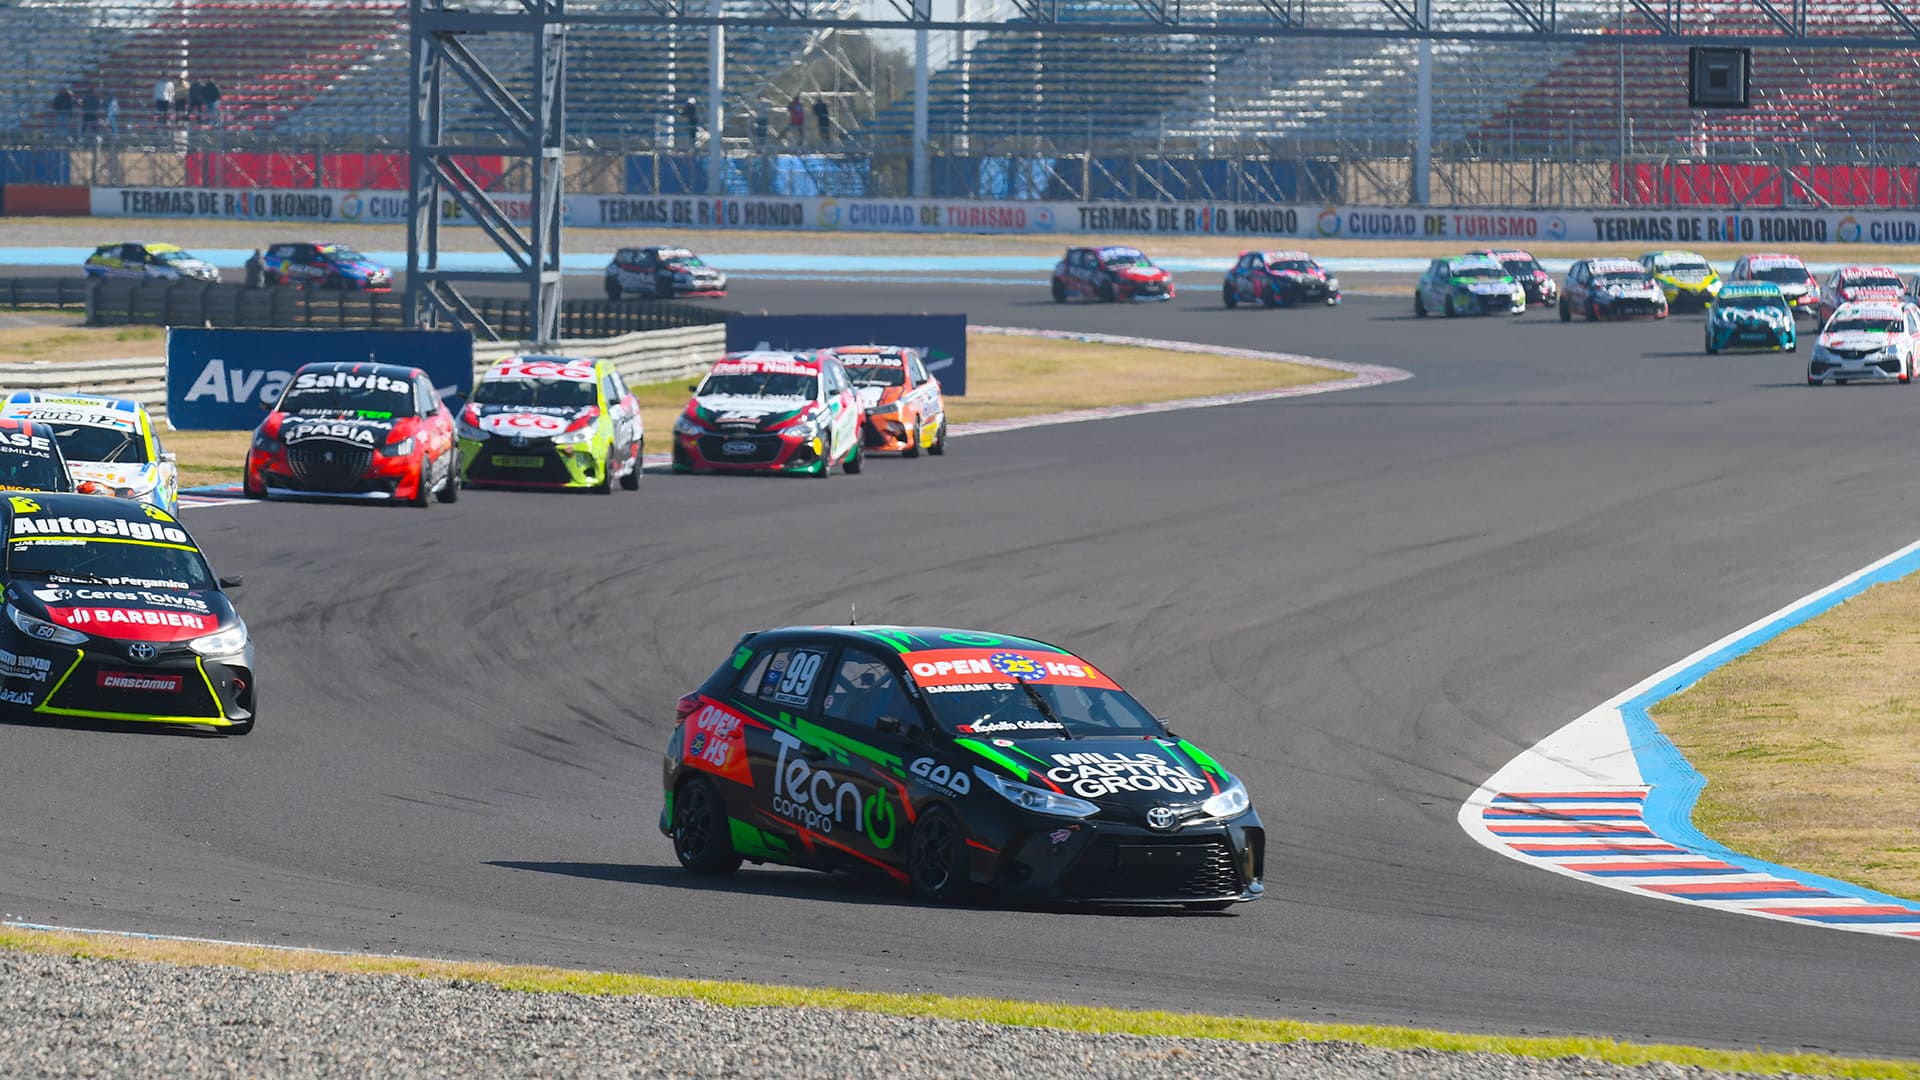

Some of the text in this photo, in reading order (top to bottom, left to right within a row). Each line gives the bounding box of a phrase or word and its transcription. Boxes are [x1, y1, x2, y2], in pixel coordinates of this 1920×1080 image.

[121, 190, 193, 214] TERMAS
[197, 191, 218, 215] DE
[271, 193, 333, 218] HONDO
[370, 196, 410, 218] CIUD
[597, 199, 667, 223] TERMAS
[671, 201, 693, 223] DE
[744, 203, 803, 226] HONDO
[848, 203, 1026, 229] CIUDAD DE TURISMO
[1077, 206, 1152, 230] TERMAS
[1156, 207, 1179, 231] DE
[1234, 208, 1297, 234] HONDO
[1348, 212, 1537, 238] CIUDAD DE TURISMO
[1593, 216, 1673, 240] TERMAS
[1677, 217, 1701, 241] DE
[1760, 217, 1827, 242] HONDO
[493, 360, 591, 379] TCG
[296, 372, 409, 394] Salvita
[29, 410, 117, 425] Ruta 12
[14, 517, 187, 542] Autosiglo
[121, 576, 189, 590] Pergamino
[76, 589, 138, 601] Ceres
[139, 591, 208, 610] Tolvas
[94, 609, 204, 630] BARBIERI
[780, 652, 822, 696] 99
[912, 658, 993, 677] OPEN
[1003, 659, 1035, 674] 25
[104, 675, 176, 691] CHASCOMUS
[926, 682, 1016, 694] DAMIANI C2
[697, 704, 741, 739] OPEN
[972, 721, 1018, 733] Rodolfo
[1050, 752, 1167, 767] MILLS
[1047, 762, 1207, 784] CAPITAL
[1072, 774, 1207, 798] GROUP
[772, 795, 832, 833] compro
